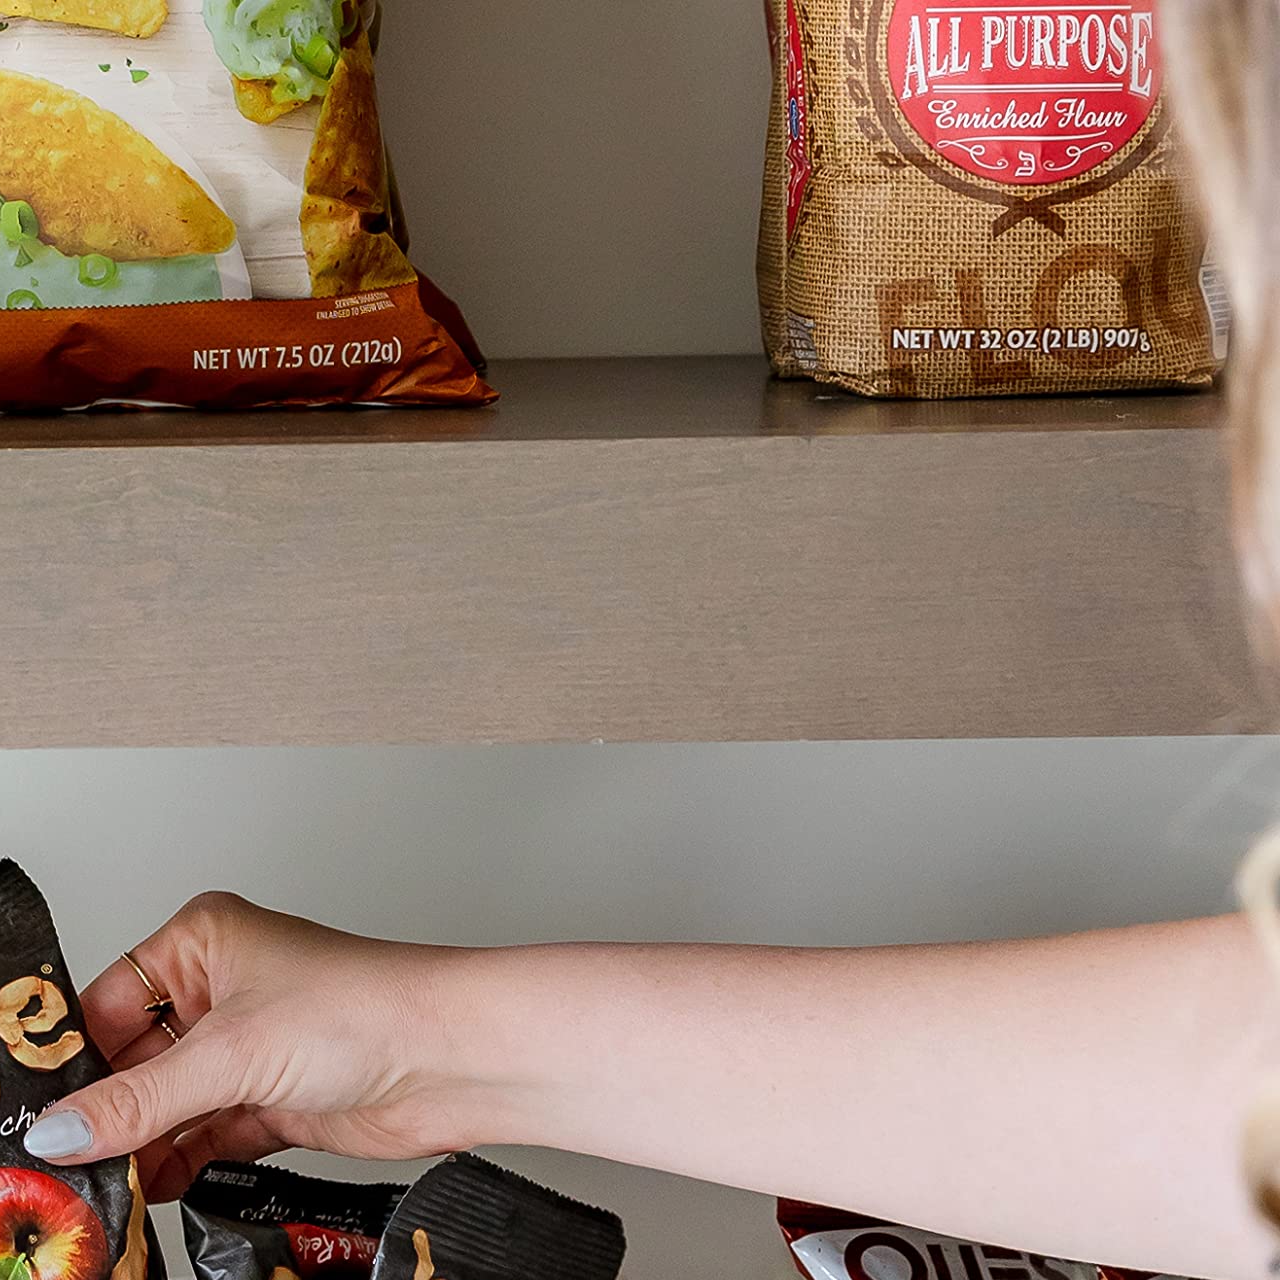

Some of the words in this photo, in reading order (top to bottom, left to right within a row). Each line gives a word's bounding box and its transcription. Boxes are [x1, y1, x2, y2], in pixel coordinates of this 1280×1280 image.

[900, 15, 974, 101] ALL
[980, 12, 1155, 101] PURPOSE
[927, 98, 1048, 131] Enriched
[1055, 98, 1128, 131] Flour
[193, 349, 231, 370] NET
[237, 348, 270, 369] WT
[276, 346, 303, 369] 7.5
[309, 344, 335, 367] OZ
[341, 336, 402, 368] (212g)
[892, 329, 934, 350] NET
[939, 330, 975, 350] WT
[979, 330, 1002, 350] 32
[1004, 329, 1038, 350] OZ
[1042, 327, 1062, 353] (2
[1066, 327, 1099, 353] LB)
[1104, 328, 1151, 353] 907g
[297, 1234, 335, 1264] Reds
[338, 1237, 352, 1260] &
[354, 1234, 377, 1260] uji
